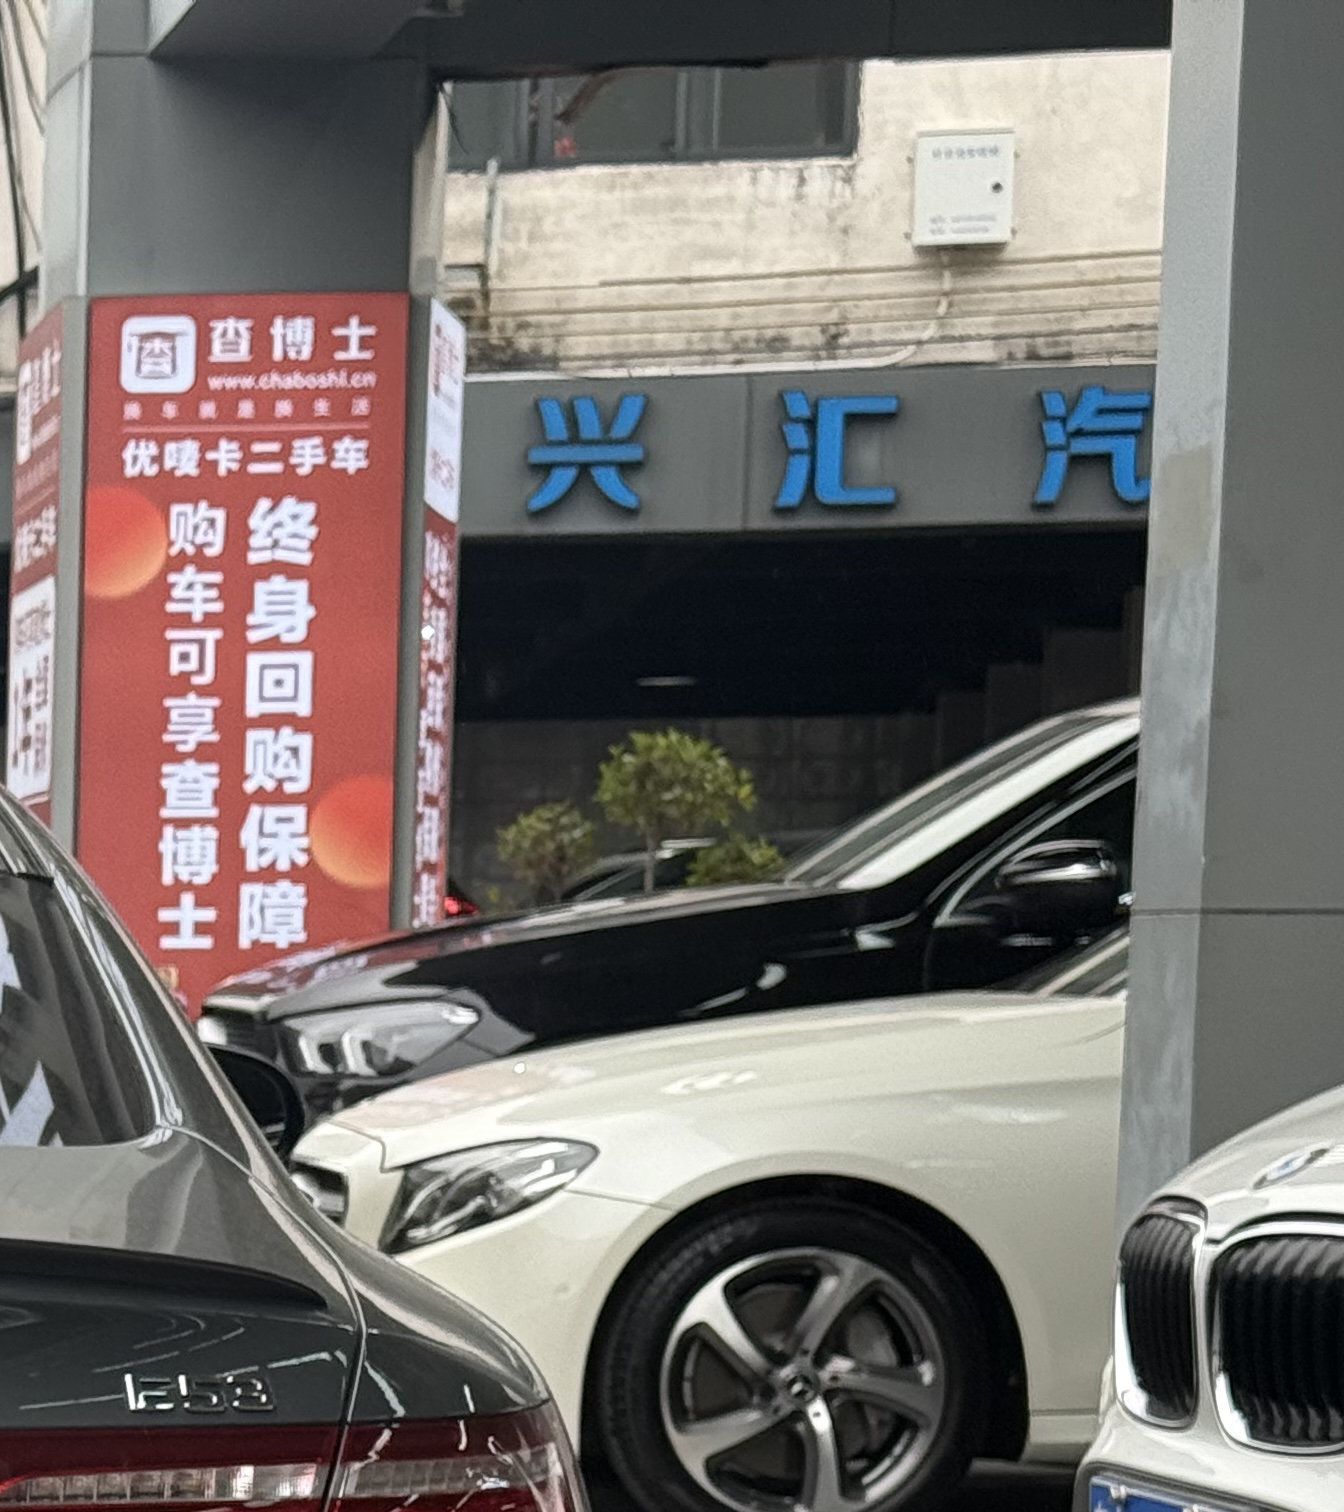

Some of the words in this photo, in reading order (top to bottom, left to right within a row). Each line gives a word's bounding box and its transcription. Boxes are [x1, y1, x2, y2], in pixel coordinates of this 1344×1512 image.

[208, 315, 378, 362] 查博士
[207, 367, 378, 391] www.chaboshi.cn
[122, 436, 369, 478] 优唛卡二手车
[527, 387, 1150, 512] 兴汇汽
[157, 501, 227, 950] 购车可享查博士
[237, 497, 319, 950] 终身回购保障
[124, 1373, 275, 1412] E53
